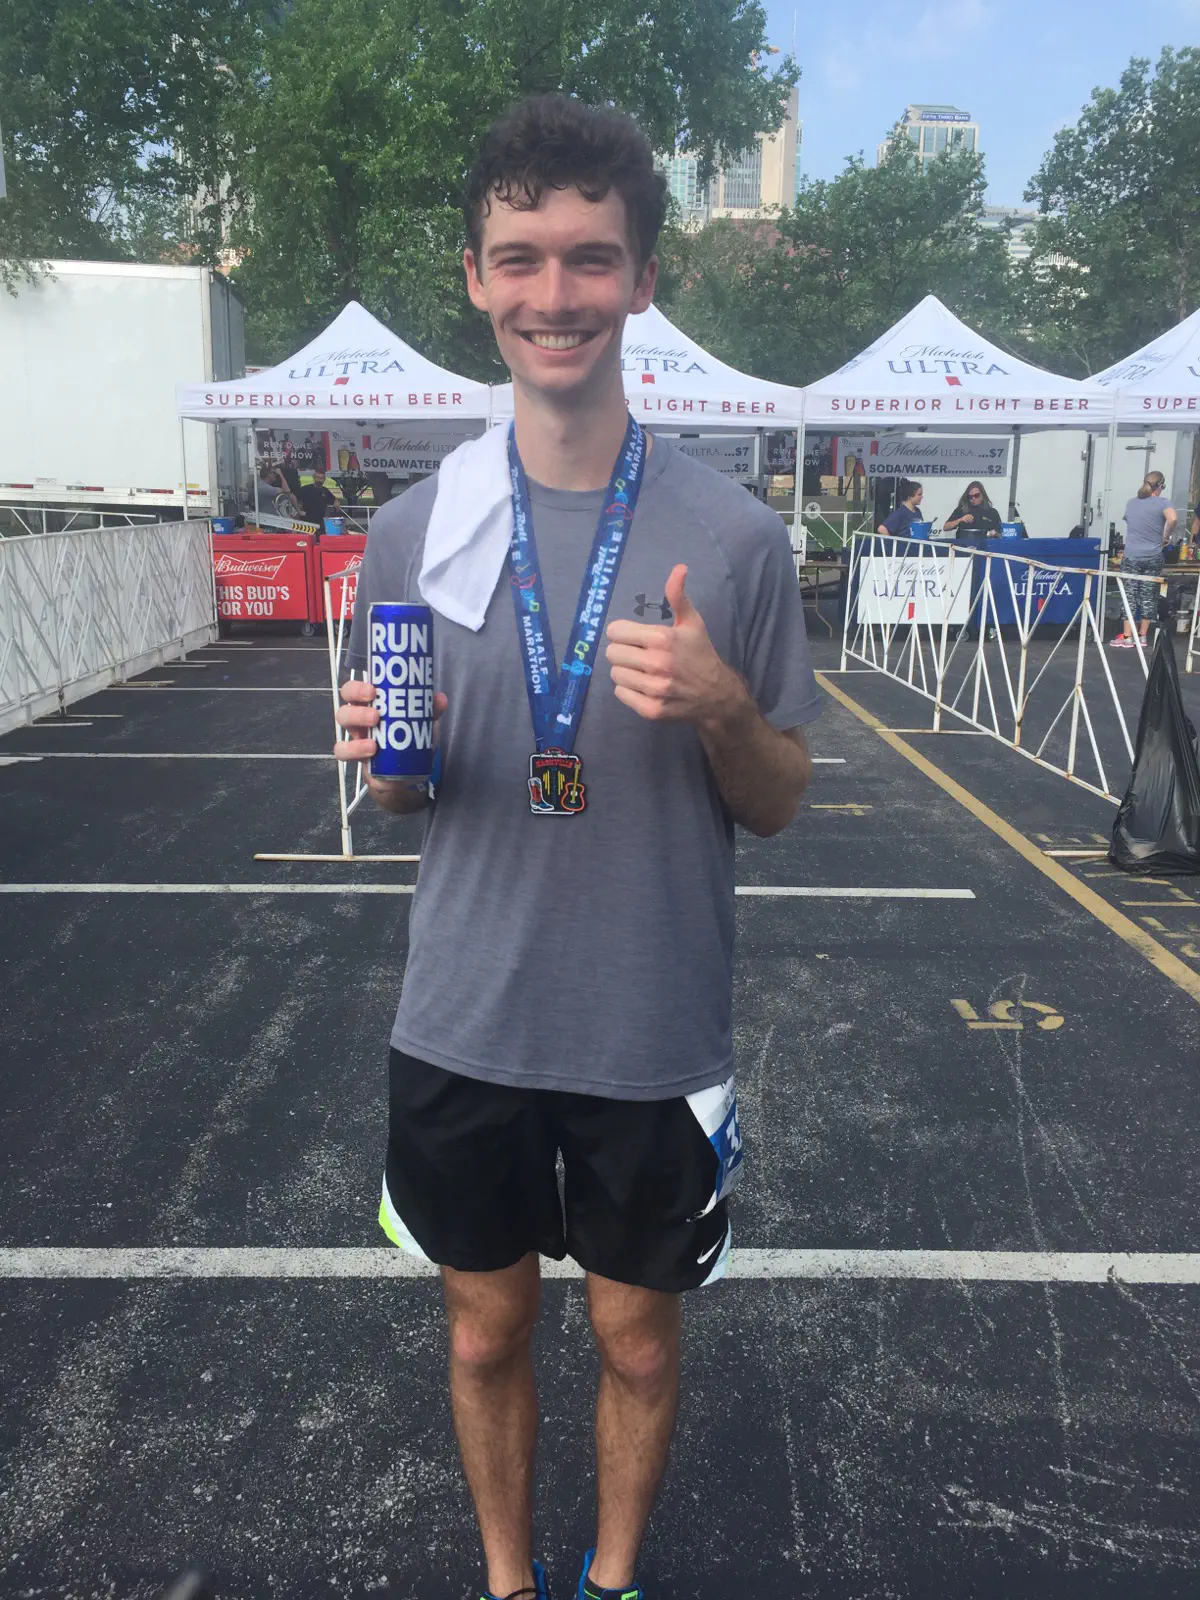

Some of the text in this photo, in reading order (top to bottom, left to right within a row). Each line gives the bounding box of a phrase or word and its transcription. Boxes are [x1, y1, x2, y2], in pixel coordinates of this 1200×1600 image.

[306, 348, 392, 366] Michelob
[900, 344, 984, 359] Michelob
[288, 360, 406, 379] ULTRA
[621, 357, 709, 375] LTRA
[886, 360, 1011, 375] ULTRA
[205, 393, 462, 406] SUPERIOR LIGHT BEER
[643, 398, 708, 412] LIGHT
[722, 401, 776, 413] BEER
[831, 398, 1089, 411] SUPERIOR LIGHT BEER
[286, 442, 312, 450] DONE
[374, 436, 431, 452] Michelob
[881, 441, 940, 457] Michelob
[940, 448, 974, 457] ULTRA
[290, 452, 314, 460] NOW
[803, 449, 820, 457] ONE
[214, 559, 281, 573] Budweiser
[579, 590, 598, 624] Rock
[592, 545, 608, 576] Roll
[585, 531, 623, 642] NASHVILLE
[246, 585, 290, 601] BUD'S
[244, 601, 274, 616] YOU
[371, 622, 429, 653] RUN
[522, 615, 543, 695] MARATHON
[534, 632, 549, 676] HALF
[371, 655, 433, 686] DONE
[374, 688, 433, 718] BEER
[372, 720, 433, 751] NOW
